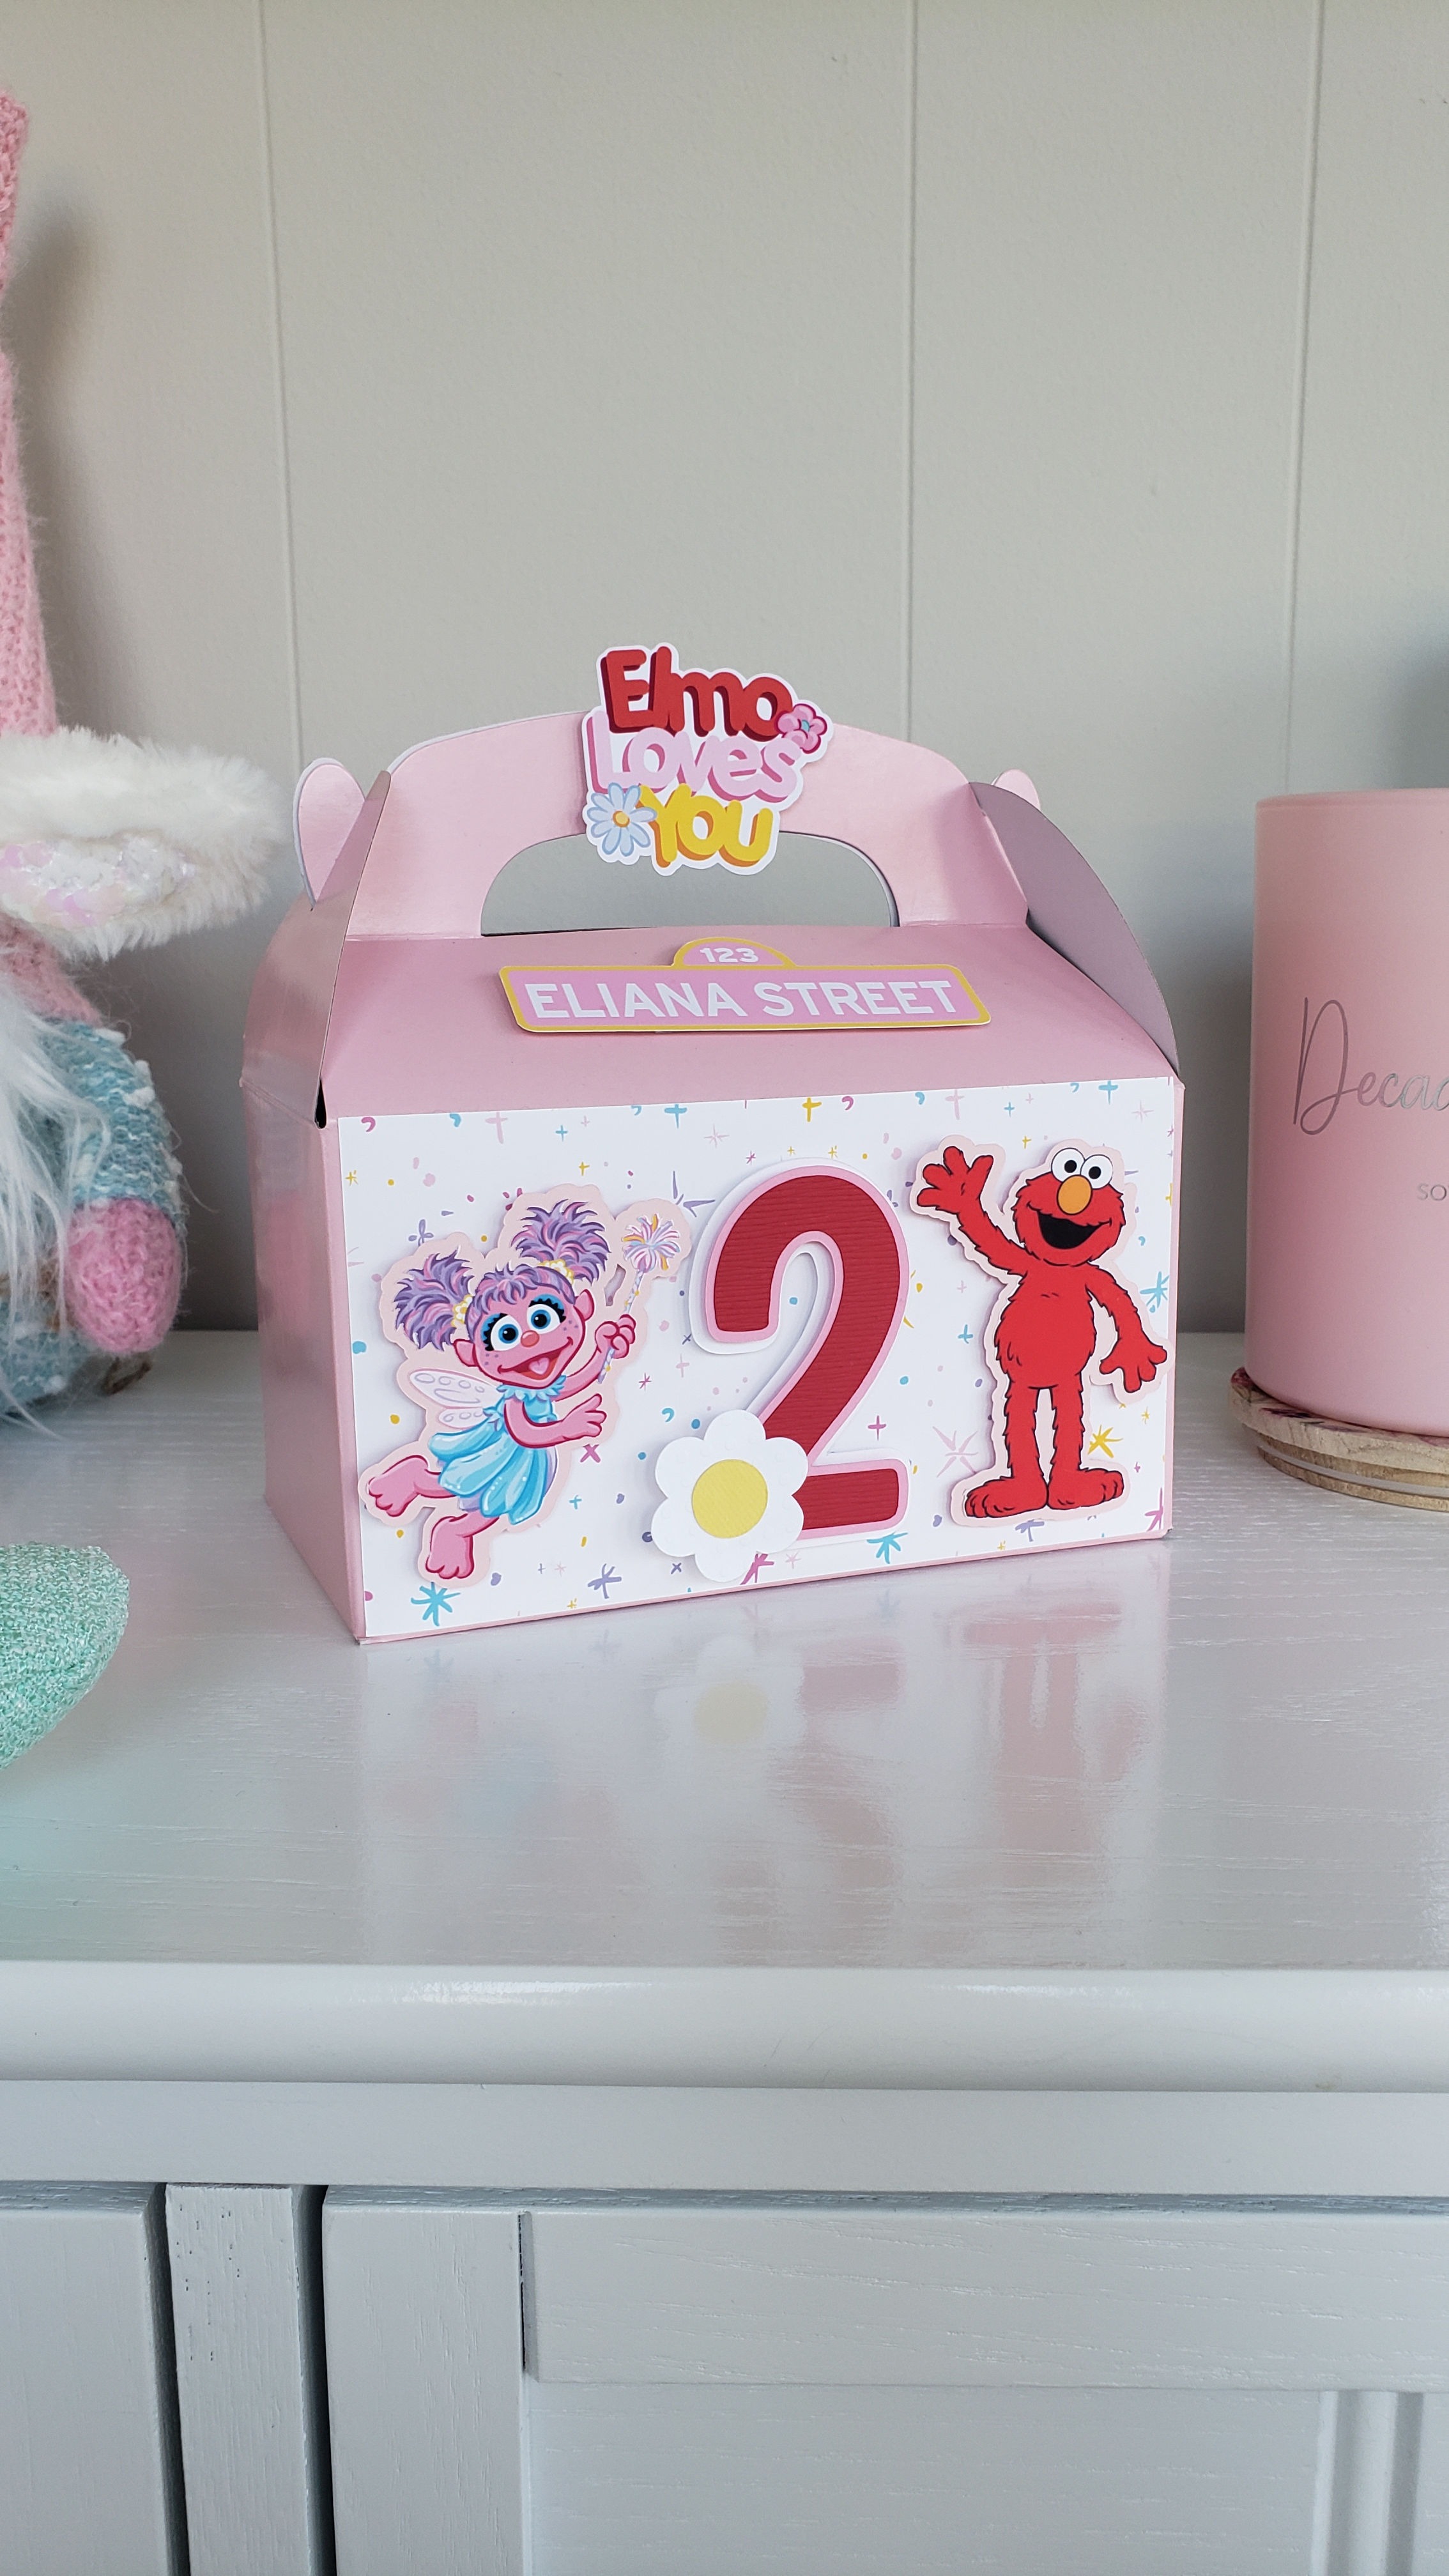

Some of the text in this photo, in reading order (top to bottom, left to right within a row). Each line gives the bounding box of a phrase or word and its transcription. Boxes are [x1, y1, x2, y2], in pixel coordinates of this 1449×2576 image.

[601, 646, 793, 742] Elmo
[586, 710, 802, 803] Loves
[700, 947, 759, 963] 123
[524, 980, 958, 1018] ELIANA STREET
[1416, 1183, 1449, 1201] SO
[705, 1165, 910, 1542] 2
